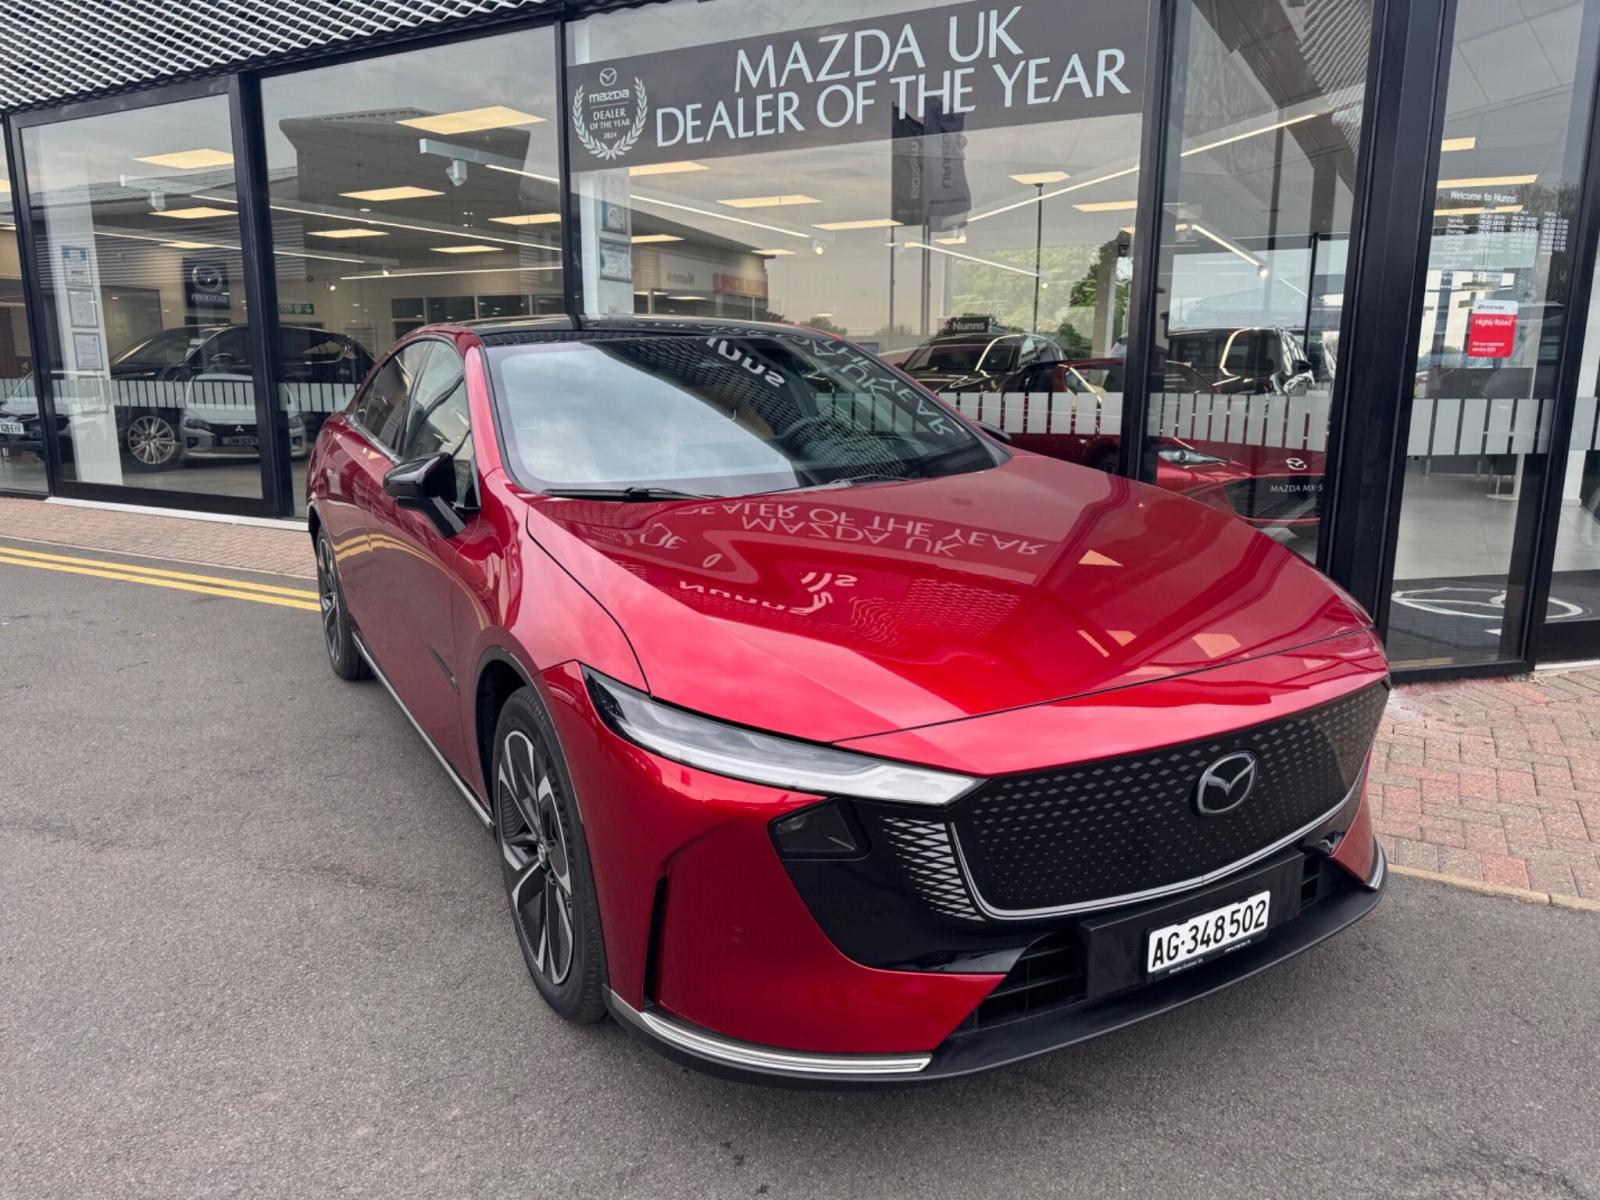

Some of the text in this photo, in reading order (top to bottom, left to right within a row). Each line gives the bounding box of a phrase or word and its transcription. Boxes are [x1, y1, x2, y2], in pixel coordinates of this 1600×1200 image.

[735, 5, 1023, 93] MAZDA UK
[588, 89, 630, 103] mazda
[656, 48, 1131, 147] DEALER OF THE YEAR
[593, 108, 626, 120] DEALER
[589, 119, 631, 130] OF THE YEAR
[1450, 190, 1481, 200] Welcome
[1484, 191, 1493, 200] to
[952, 321, 985, 331] Nunns
[1270, 484, 1301, 493] MAZDA
